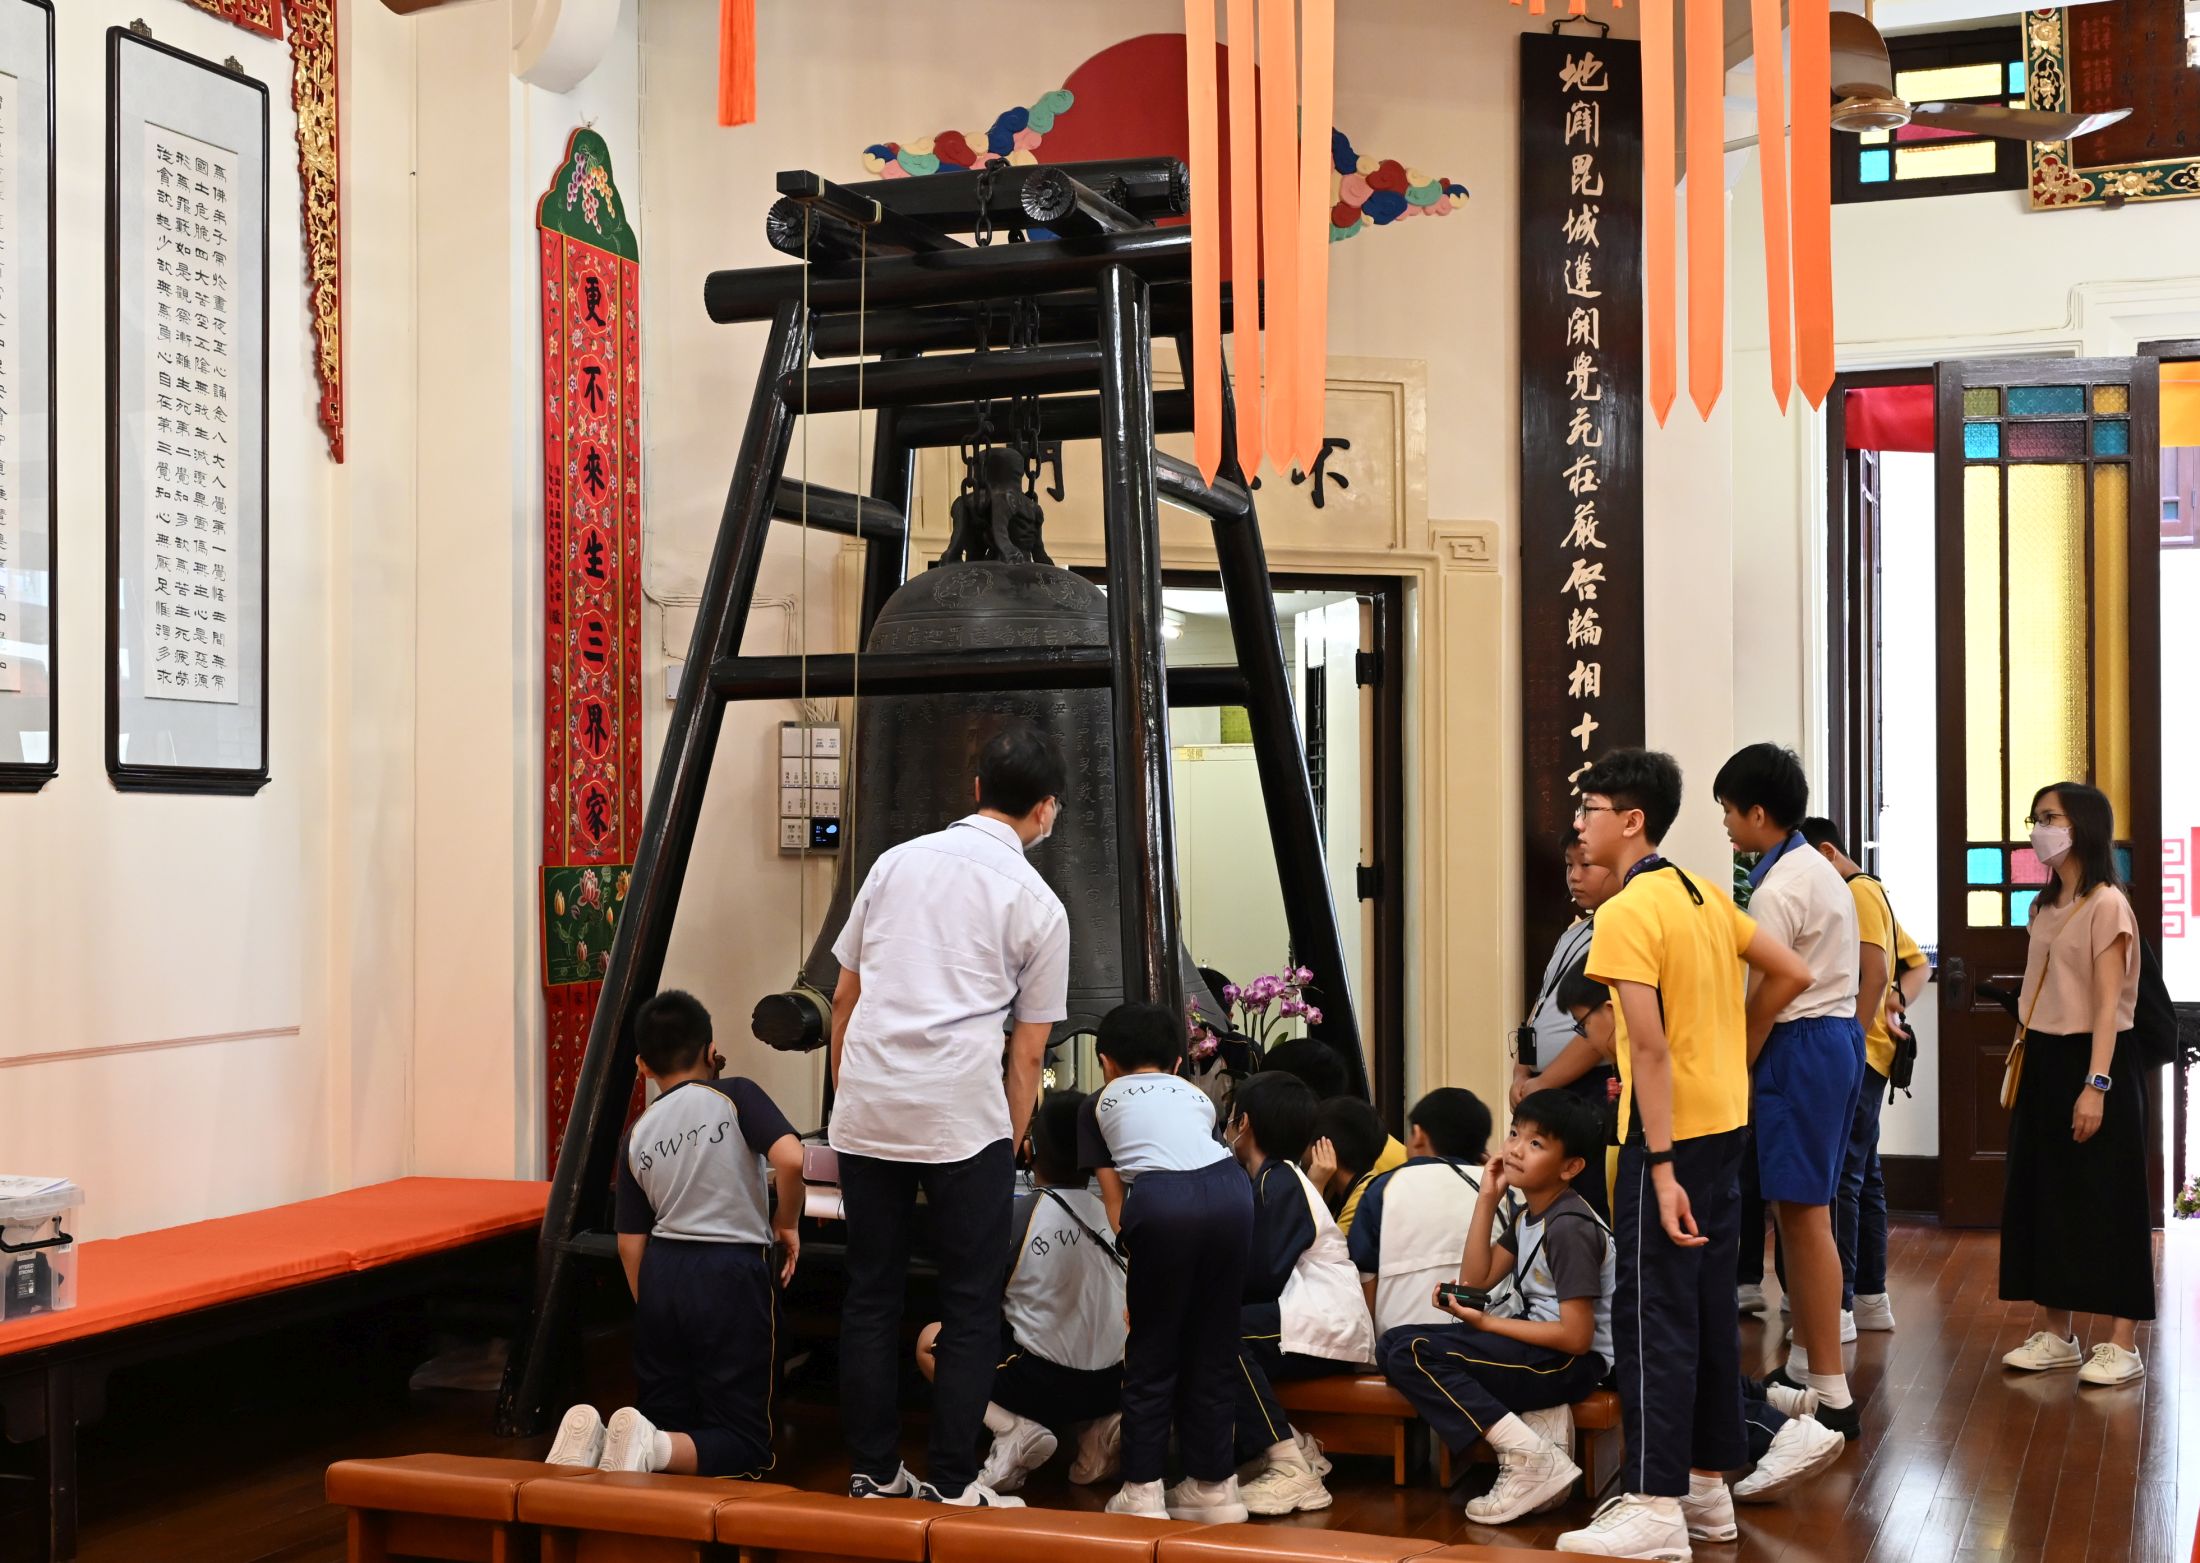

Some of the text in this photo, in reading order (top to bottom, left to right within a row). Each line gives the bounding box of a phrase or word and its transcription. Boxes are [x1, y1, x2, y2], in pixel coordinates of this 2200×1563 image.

[583, 277, 607, 841] 更不來生三界家
